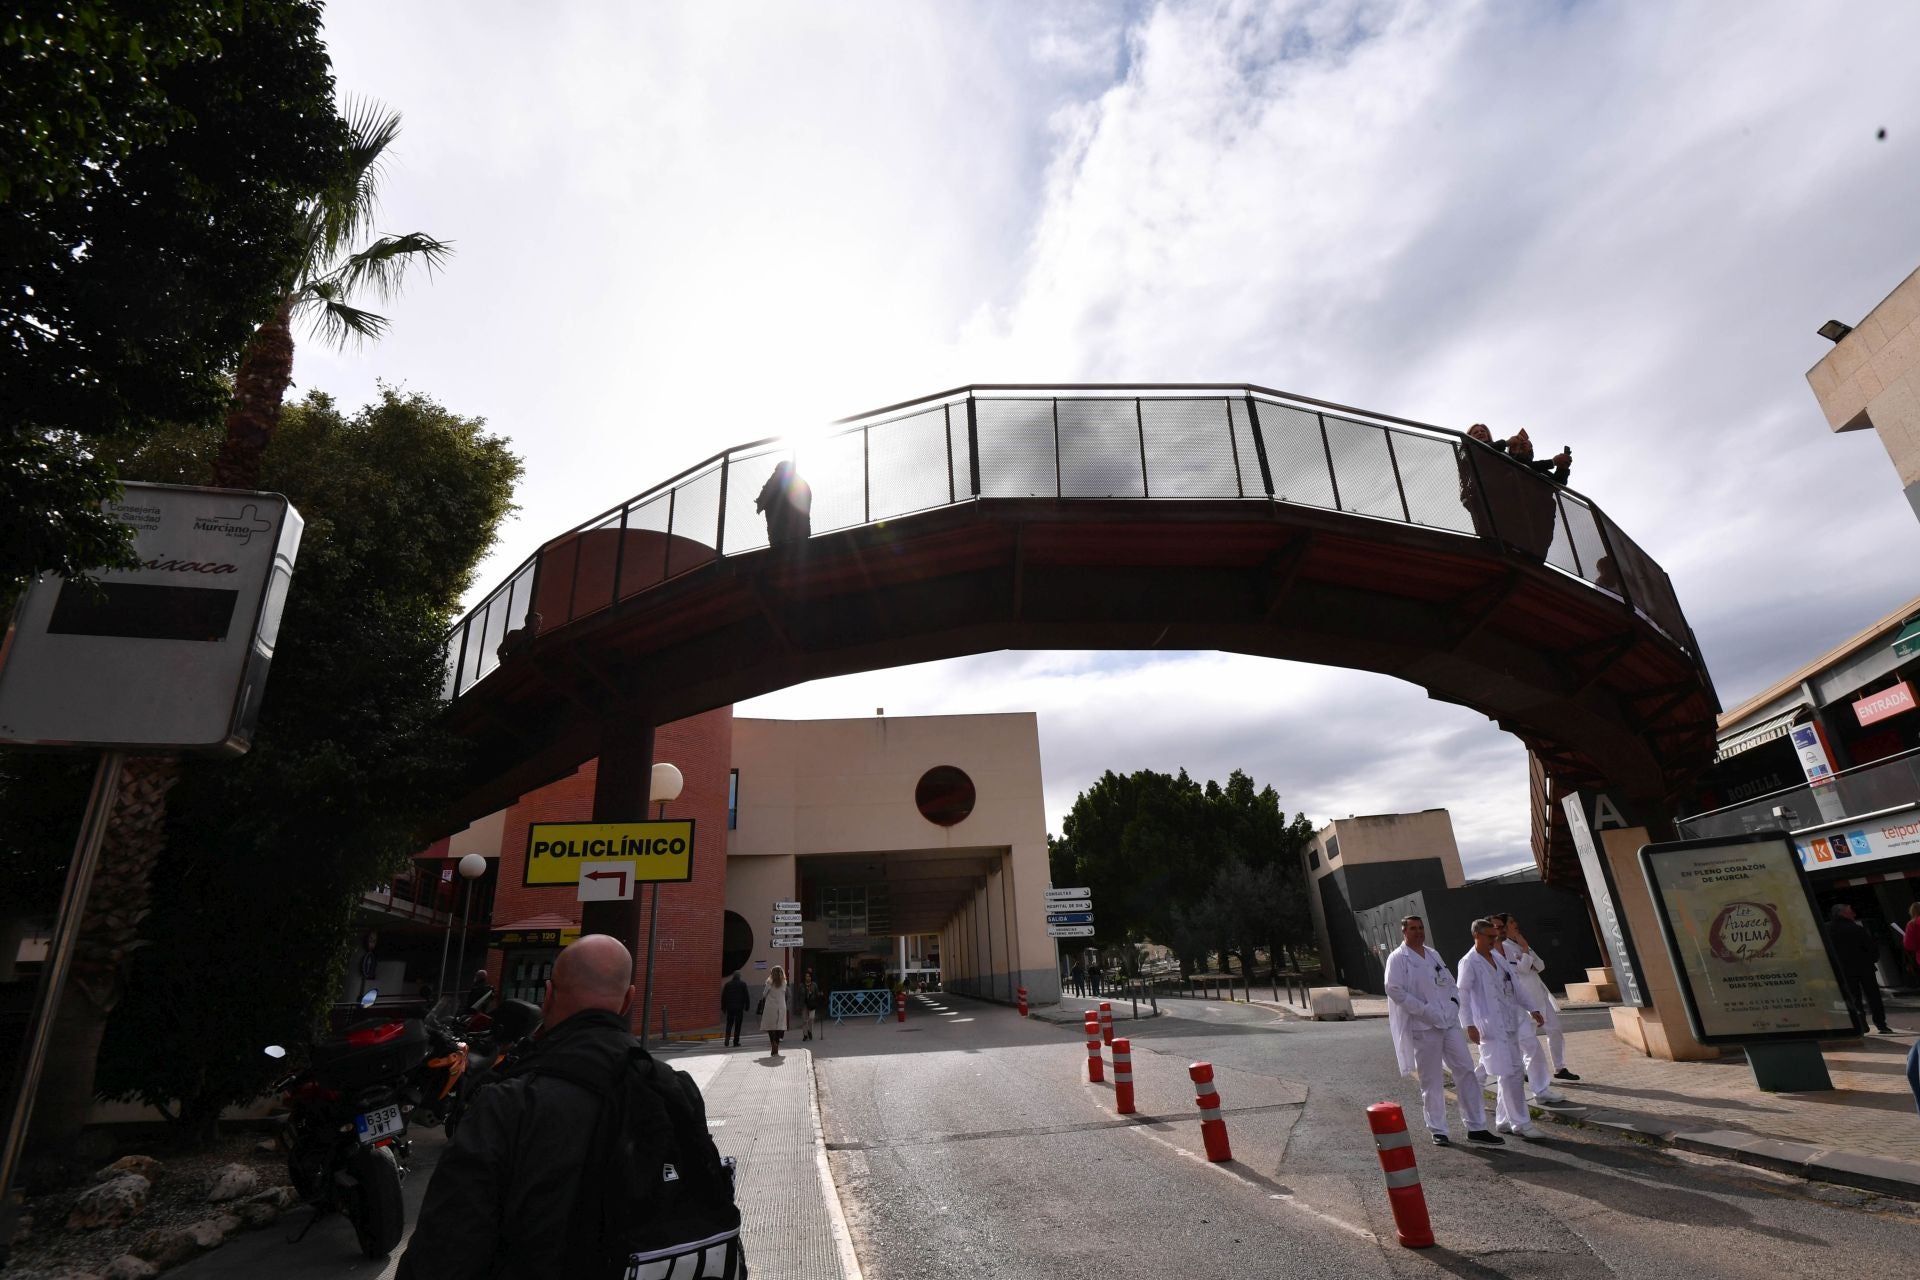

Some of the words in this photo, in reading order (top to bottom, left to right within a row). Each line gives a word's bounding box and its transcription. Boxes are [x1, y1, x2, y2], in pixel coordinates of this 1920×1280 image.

[121, 512, 161, 523] Sanidad
[193, 522, 250, 534] Murciano
[1858, 691, 1909, 719] ENTRADA
[1568, 799, 1588, 836] A
[1594, 793, 1630, 830] A
[1881, 821, 1920, 840] telpar
[533, 835, 686, 858] POLICLÍNICO
[1694, 868, 1722, 876] PLENO
[1715, 873, 1750, 881] MURCIA
[1730, 930, 1772, 943] VILMA
[1601, 891, 1641, 1004] ENTRADA
[1755, 973, 1781, 981] TODOS
[367, 1108, 397, 1126] 6338
[370, 1120, 391, 1136] JWT
